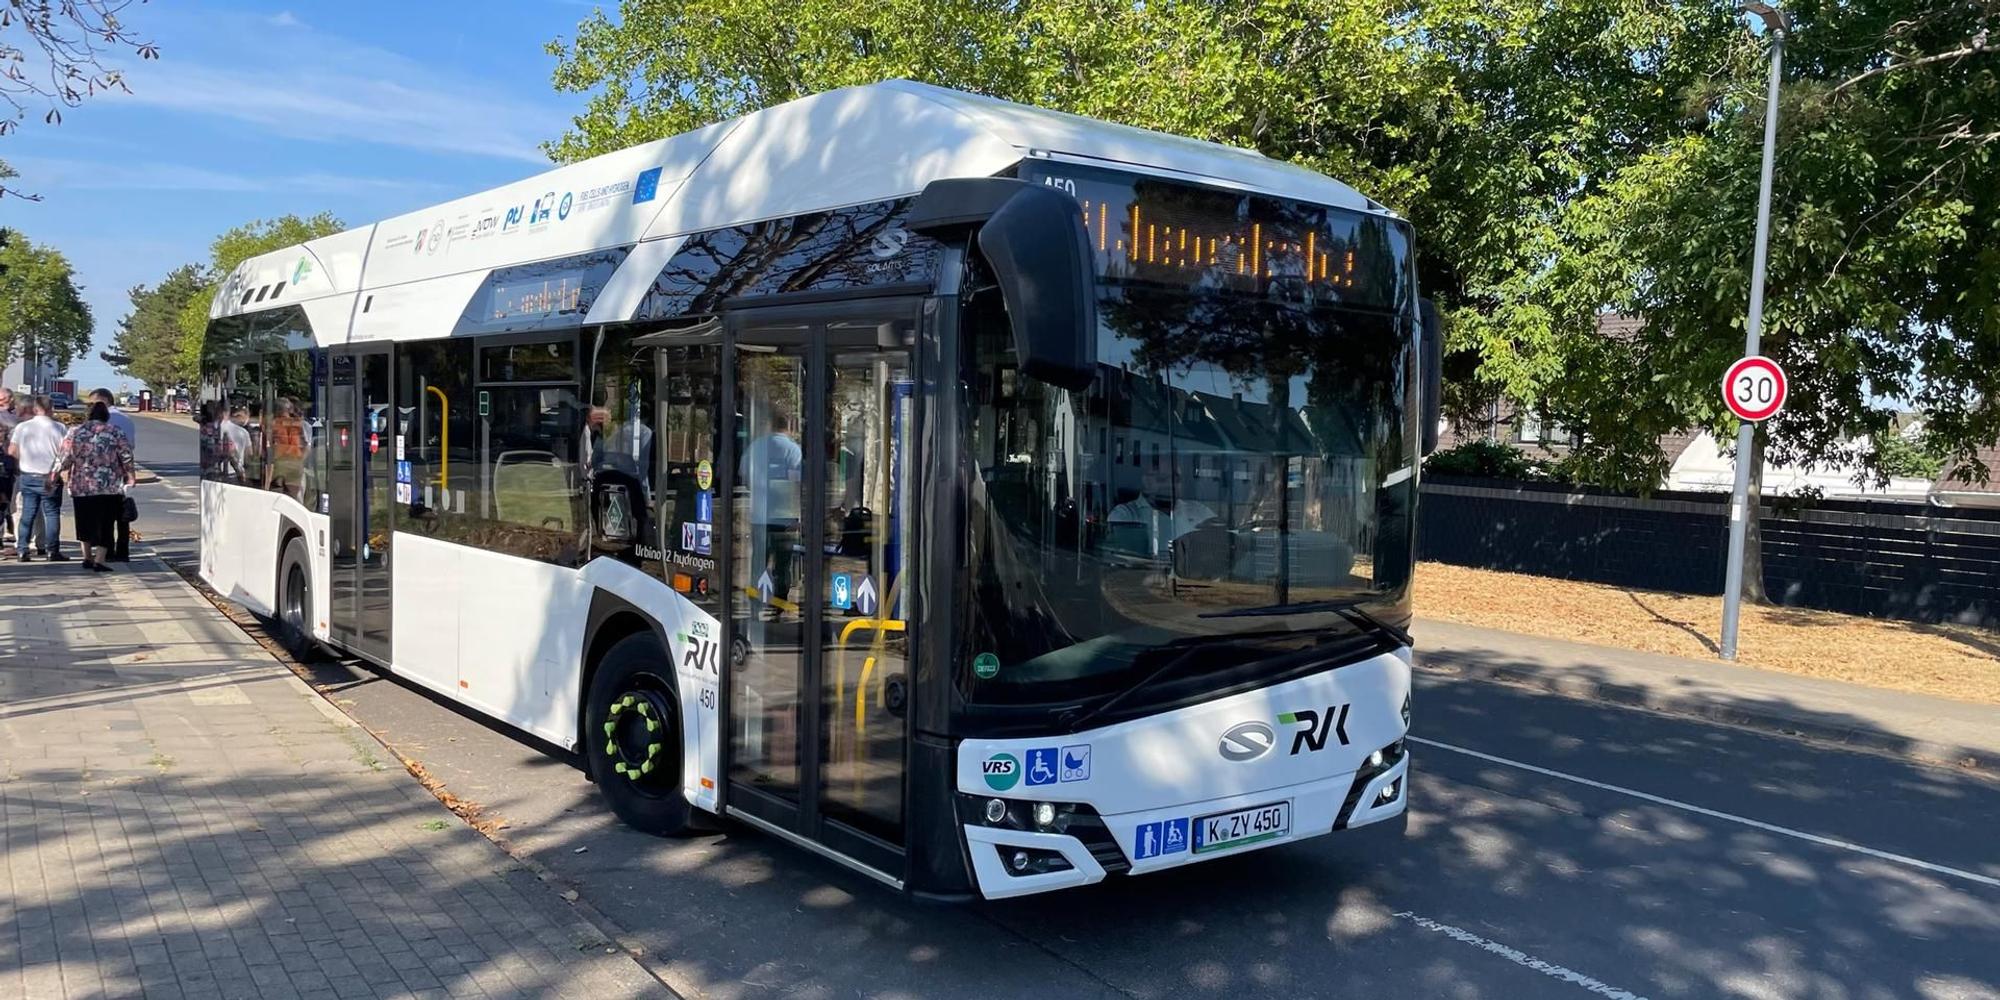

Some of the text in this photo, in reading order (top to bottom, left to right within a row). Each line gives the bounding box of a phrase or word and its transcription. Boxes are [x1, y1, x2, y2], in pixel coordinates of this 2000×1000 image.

[1738, 376, 1772, 403] 30
[635, 544, 715, 571] Urbino 12 hydrogen
[700, 687, 715, 710] 450
[982, 761, 1012, 773] VRS
[1209, 808, 1281, 843] K ZY 450
